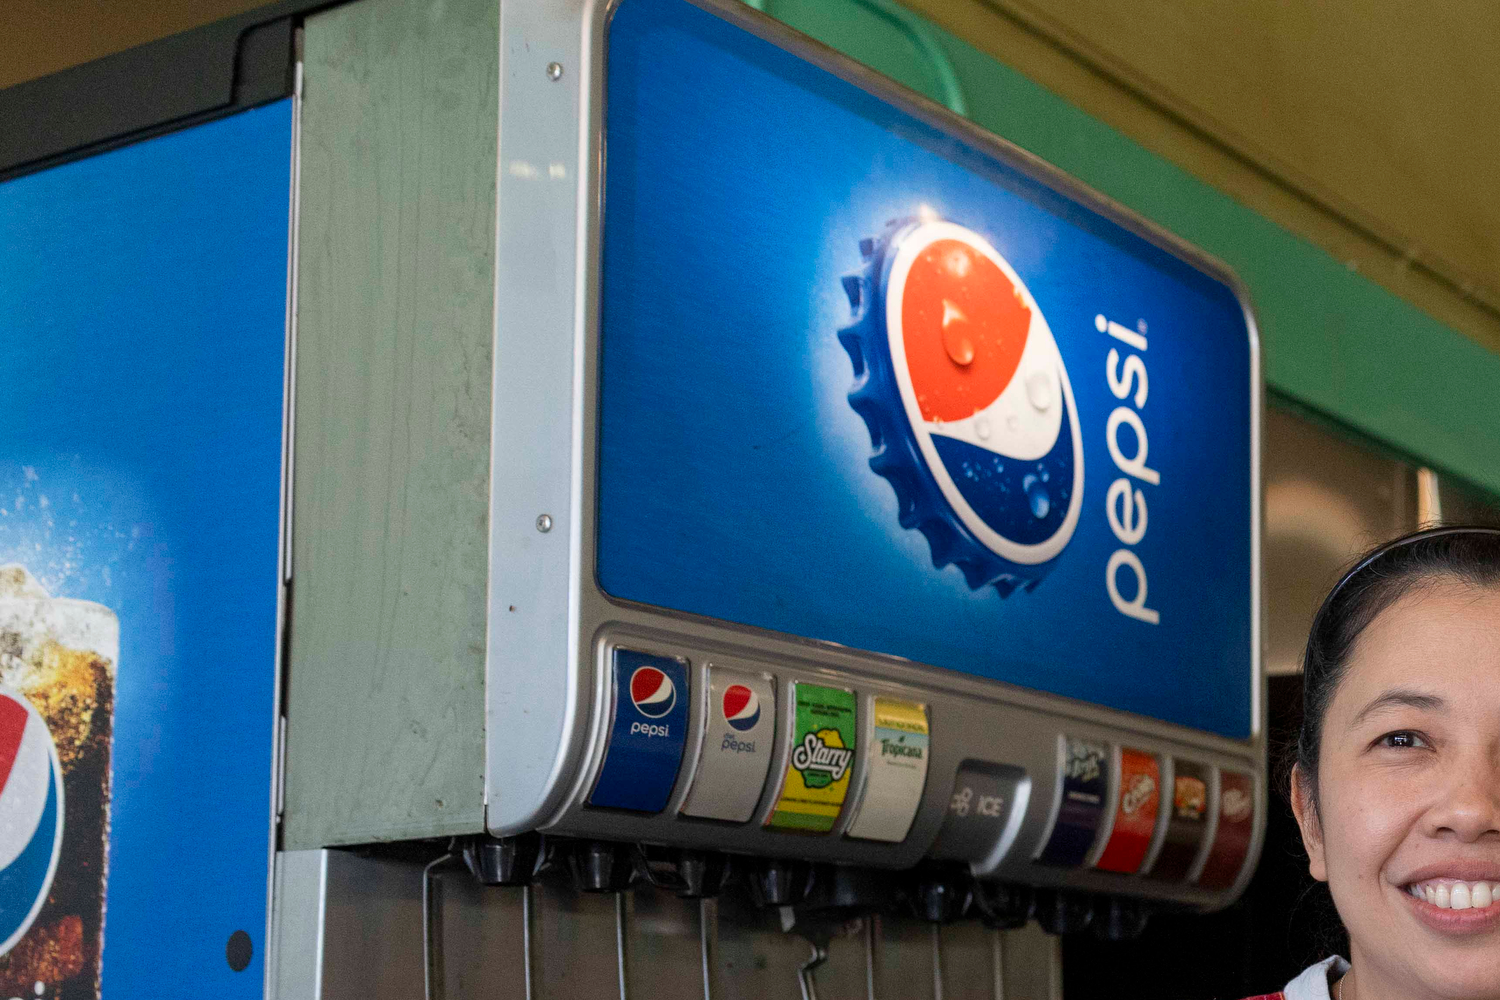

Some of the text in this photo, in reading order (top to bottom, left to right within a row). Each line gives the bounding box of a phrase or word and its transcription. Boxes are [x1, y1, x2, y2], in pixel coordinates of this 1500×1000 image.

[1094, 313, 1160, 626] pepsi
[630, 721, 670, 738] pepsi
[720, 737, 756, 754] pepsi
[793, 733, 853, 780] Starry
[881, 738, 923, 760] Tropicana
[976, 794, 1004, 817] ICE
